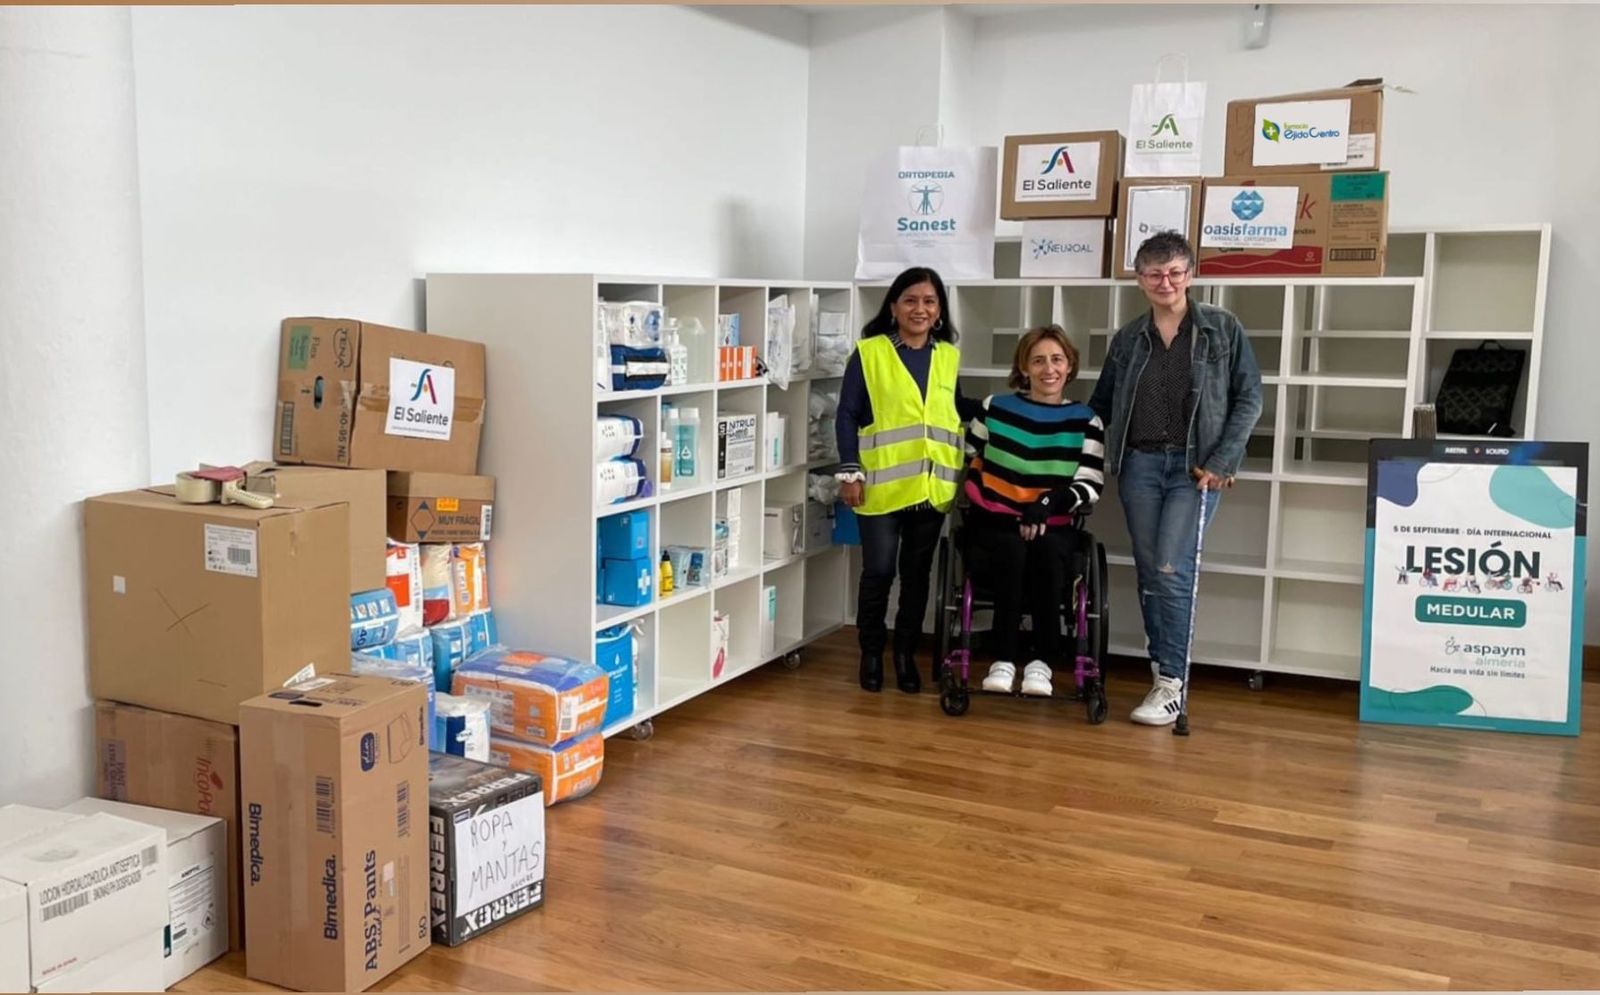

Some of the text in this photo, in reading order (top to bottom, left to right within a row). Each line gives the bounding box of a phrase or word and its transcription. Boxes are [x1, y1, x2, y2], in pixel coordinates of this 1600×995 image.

[1135, 139, 1193, 150] El Saliente
[897, 171, 955, 179] ORTOPEDIA
[1022, 179, 1092, 191] El Saliente
[897, 217, 956, 231] Sanest
[1204, 223, 1287, 236] oasisfarma
[1047, 243, 1093, 253] NEUROAL
[394, 406, 449, 426] El Saliente
[1393, 525, 1399, 533] 5
[1413, 526, 1460, 535] SEPTIEMBRE
[1466, 525, 1482, 536] DÍA
[1484, 529, 1552, 539] INTERNACIONAL
[1406, 541, 1540, 580] LESIÓN
[1427, 603, 1515, 620] MEDULAR
[1463, 643, 1525, 657] aspaym
[1430, 665, 1451, 674] Hacia
[1469, 668, 1484, 676] vida
[470, 810, 513, 848] ROPA
[469, 840, 541, 899] MANTAS
[364, 849, 377, 918] Pants
